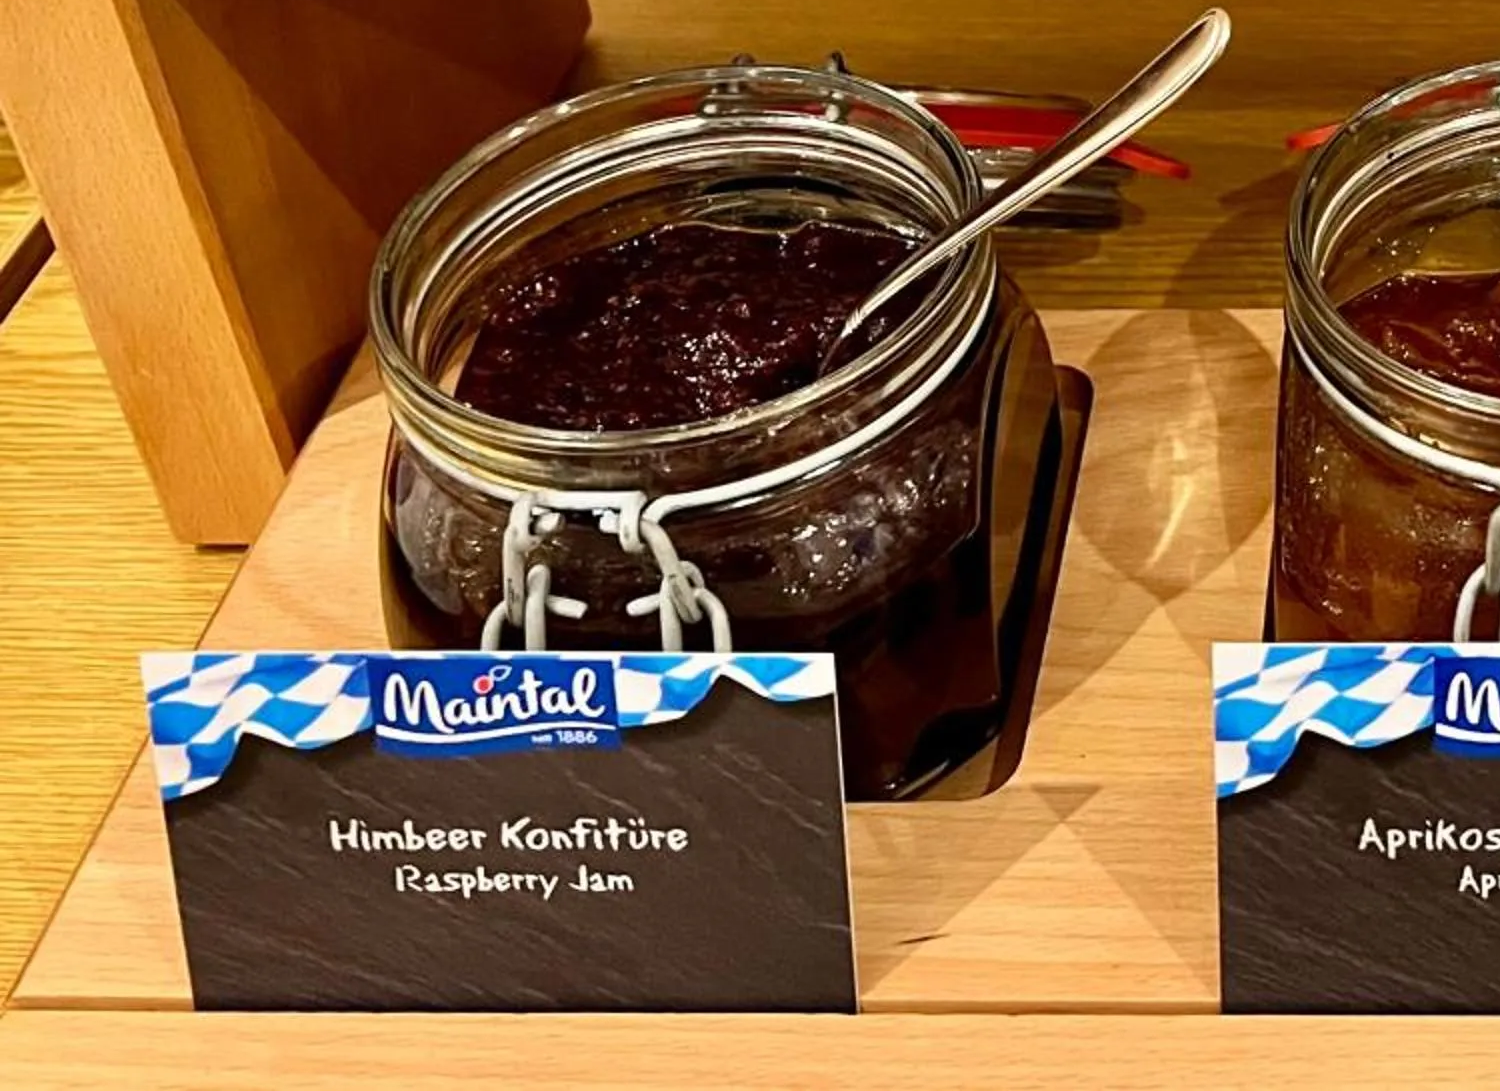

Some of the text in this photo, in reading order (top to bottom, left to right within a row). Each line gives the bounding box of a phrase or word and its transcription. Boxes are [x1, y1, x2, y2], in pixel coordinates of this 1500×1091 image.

[383, 667, 605, 733] Maintal
[555, 730, 598, 744] 1886
[330, 816, 689, 852] Himbeer Konfitüre
[395, 864, 634, 901] Raspberry Jam
